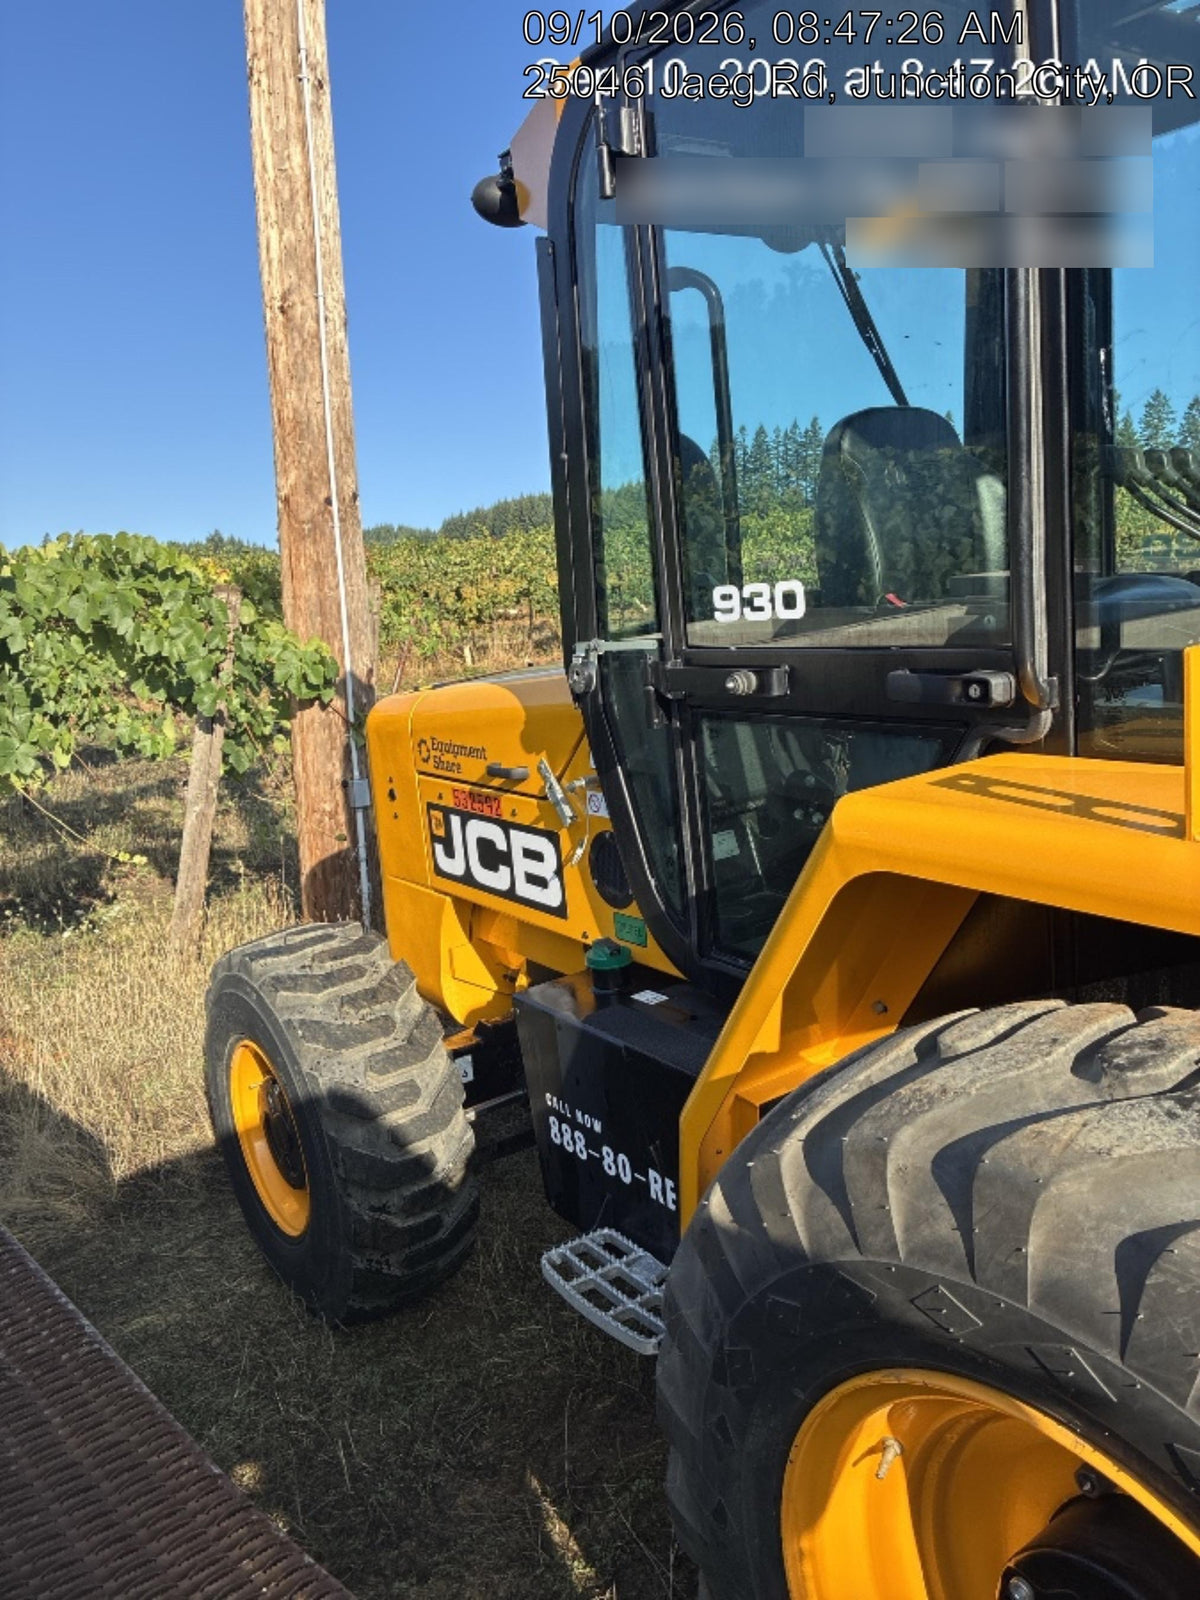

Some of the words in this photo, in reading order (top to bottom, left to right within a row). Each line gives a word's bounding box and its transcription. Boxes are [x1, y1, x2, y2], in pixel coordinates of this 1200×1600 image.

[712, 579, 806, 623] 930
[430, 736, 488, 761] Equipment
[433, 755, 463, 774] Share
[433, 813, 563, 908] JCB
[545, 1092, 572, 1118] CALL
[575, 1108, 602, 1134] NOW
